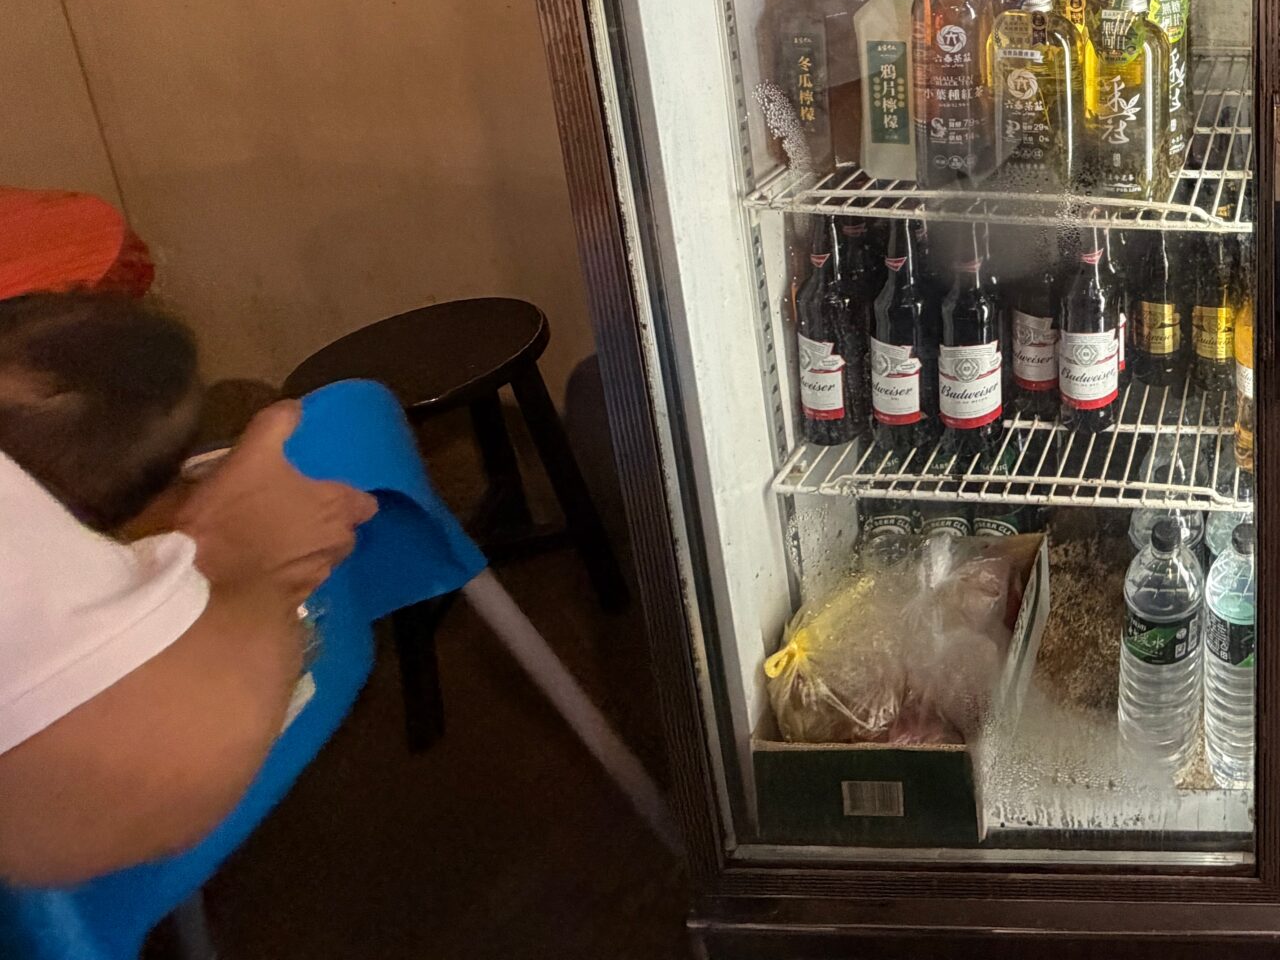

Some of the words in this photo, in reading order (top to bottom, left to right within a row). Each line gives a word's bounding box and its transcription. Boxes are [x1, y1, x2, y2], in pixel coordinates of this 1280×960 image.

[1061, 367, 1115, 383] Budweiser
[871, 381, 912, 396] dweiser
[941, 382, 999, 400] Budweiser
